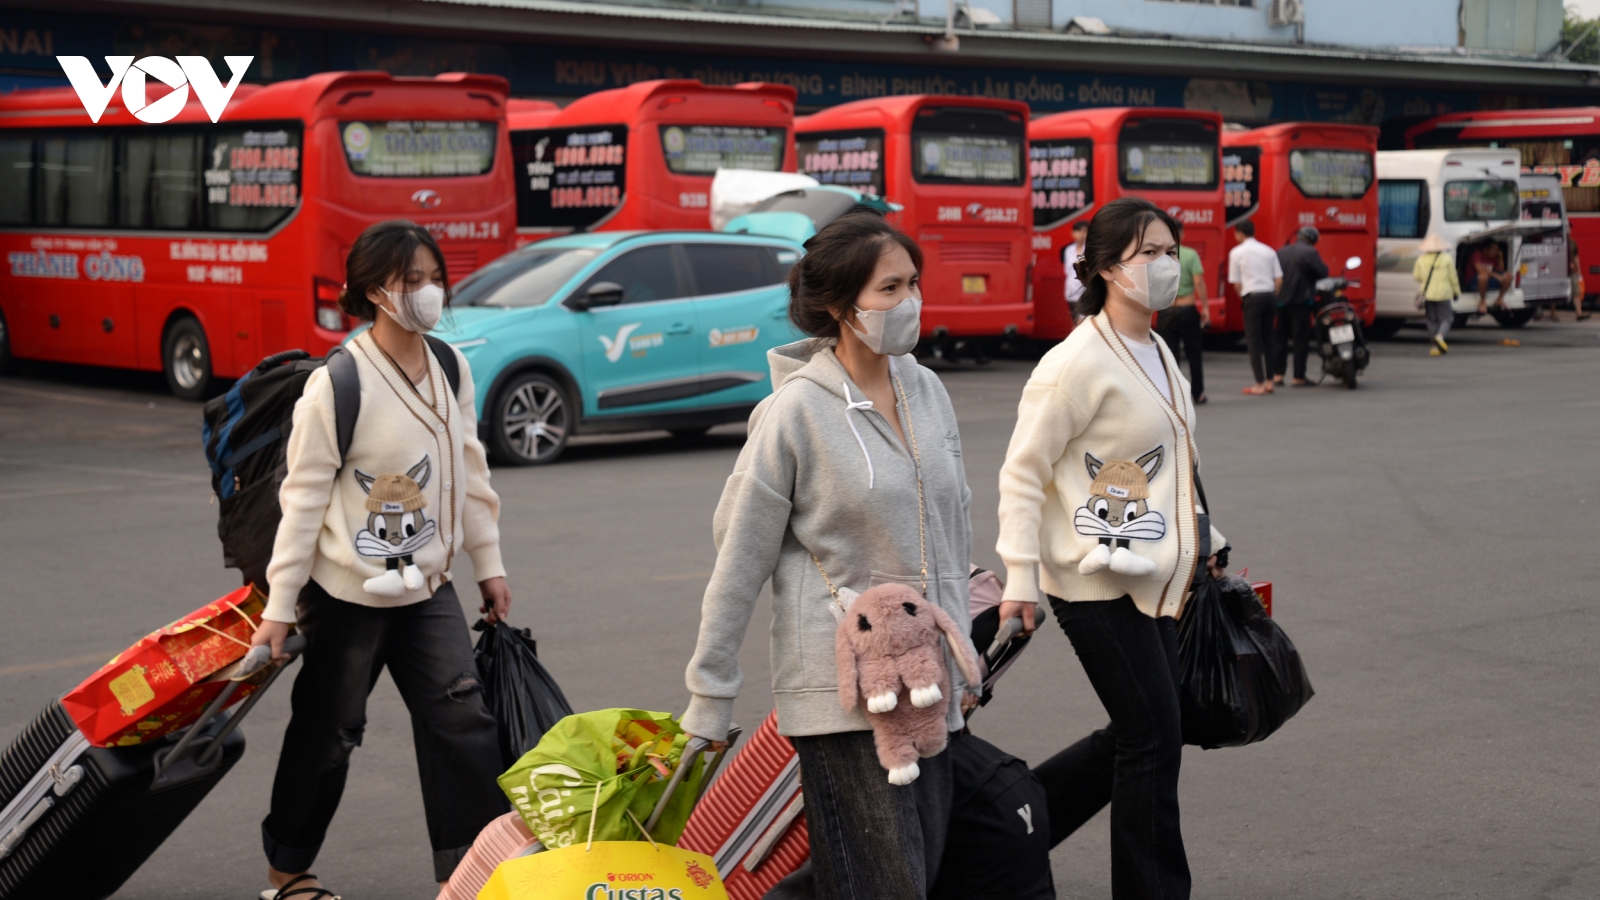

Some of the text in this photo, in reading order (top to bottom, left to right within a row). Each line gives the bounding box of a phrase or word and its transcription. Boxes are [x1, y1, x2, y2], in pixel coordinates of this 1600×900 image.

[554, 60, 606, 85] KHU
[841, 73, 886, 96] BÌNH
[1128, 87, 1155, 106] NAI
[8, 249, 79, 279] THÀNH
[83, 250, 146, 283] CÔNG
[618, 872, 654, 882] ORION
[585, 881, 684, 900] Custas
